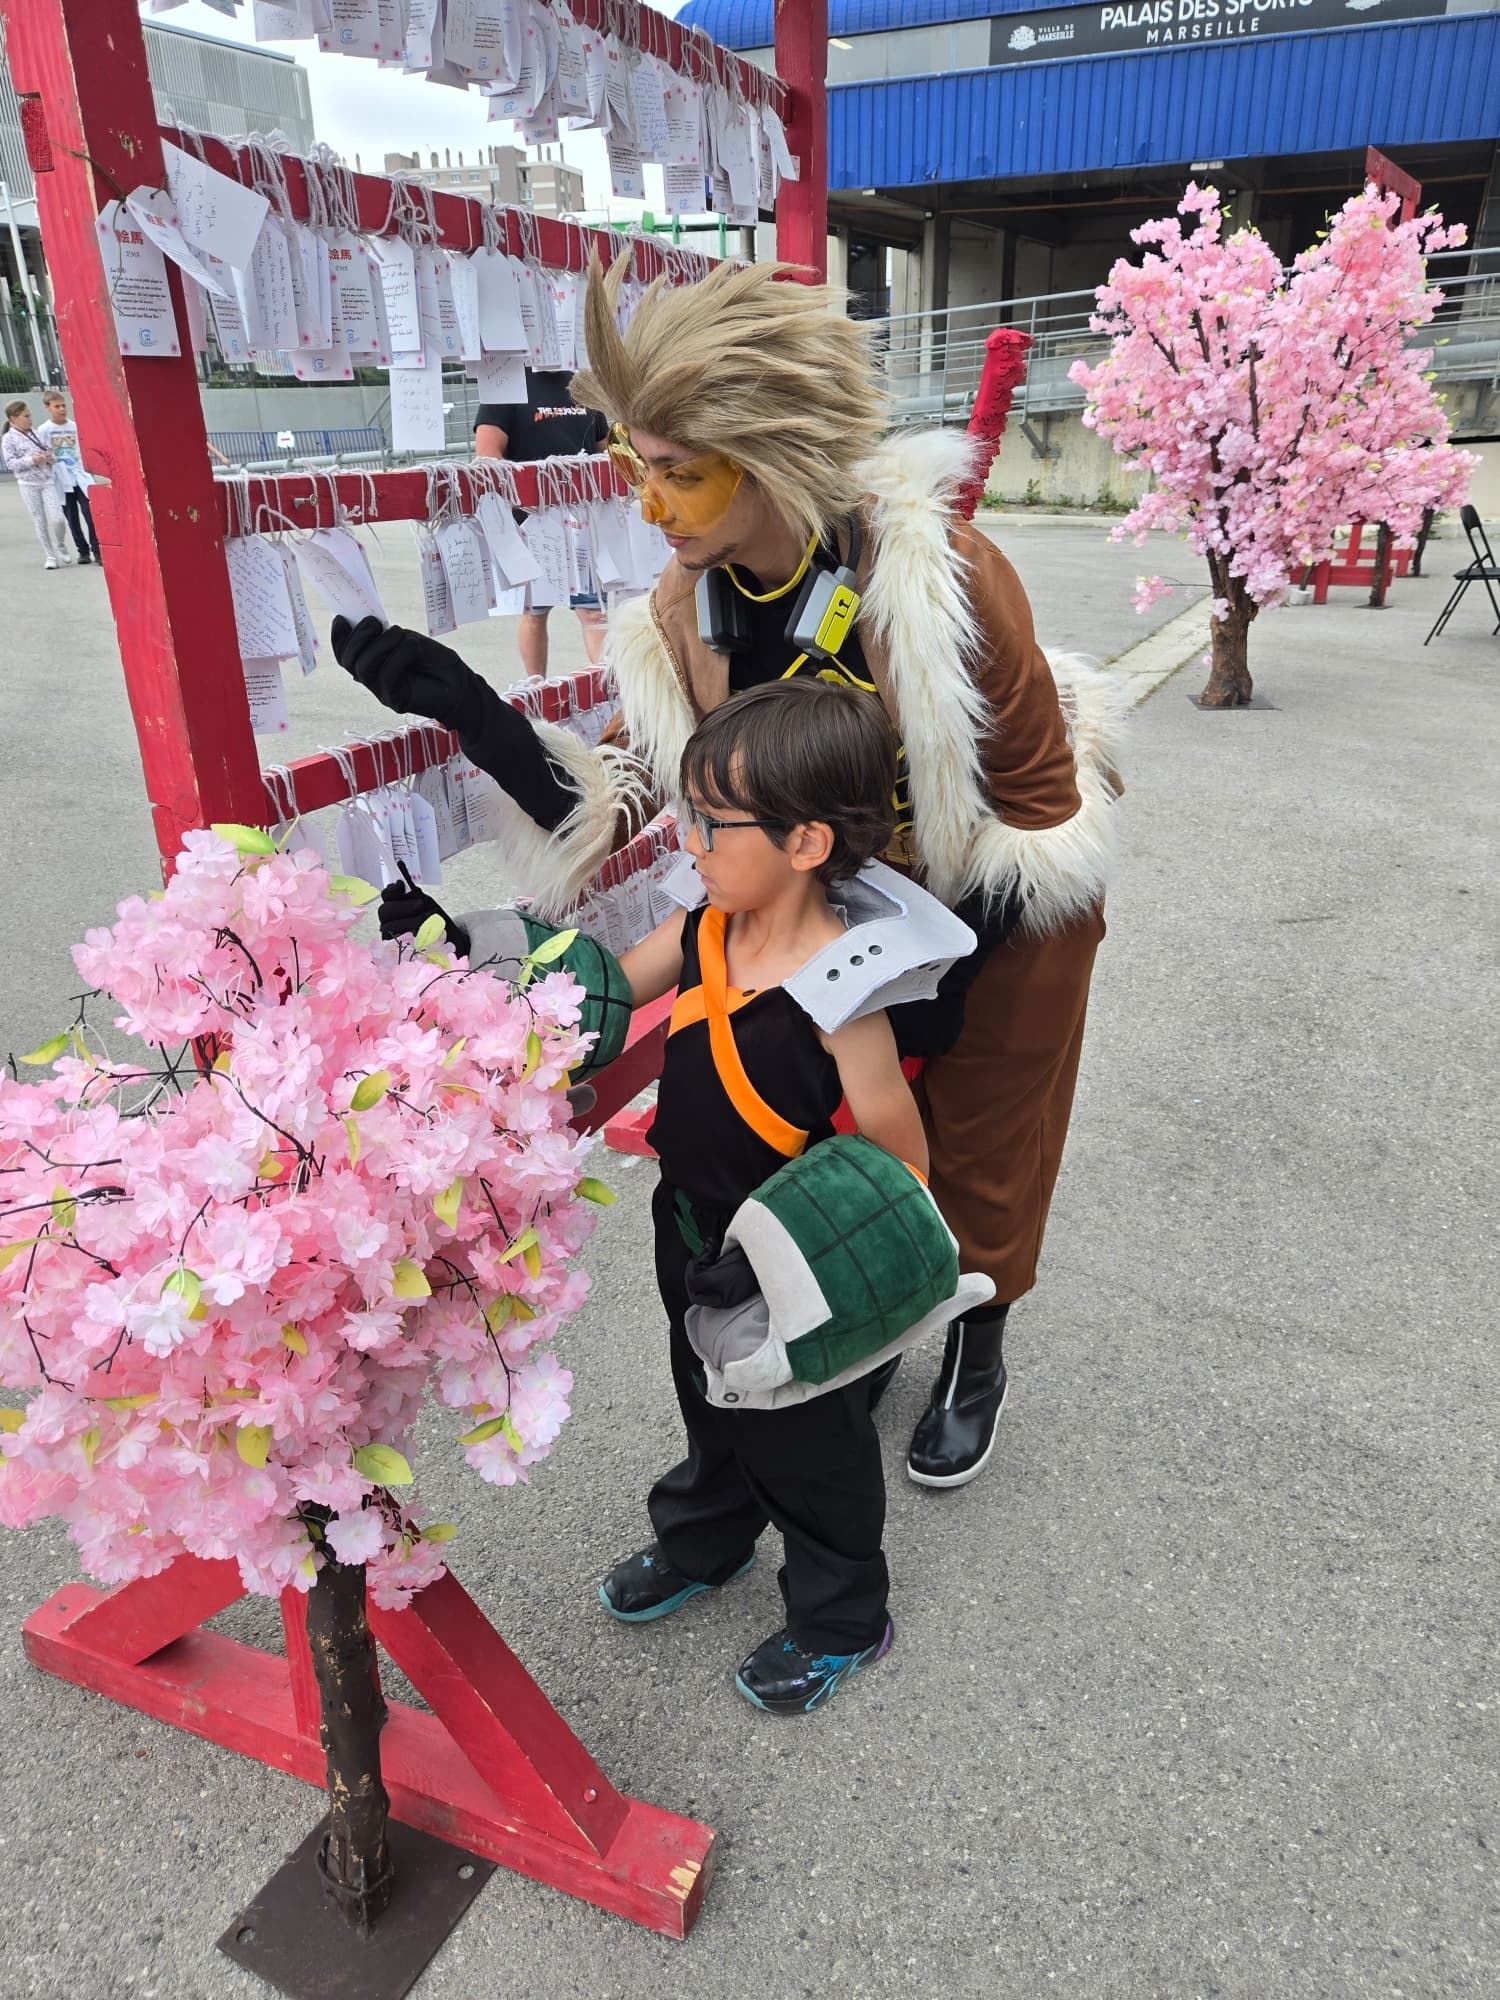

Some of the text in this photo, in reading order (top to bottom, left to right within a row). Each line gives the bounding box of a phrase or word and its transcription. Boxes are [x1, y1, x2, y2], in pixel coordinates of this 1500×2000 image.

[1100, 0, 1174, 31] PALAIS
[1178, 0, 1221, 21] DES
[1037, 30, 1075, 43] MARSEILLE
[1147, 16, 1260, 44] MARSEILLE
